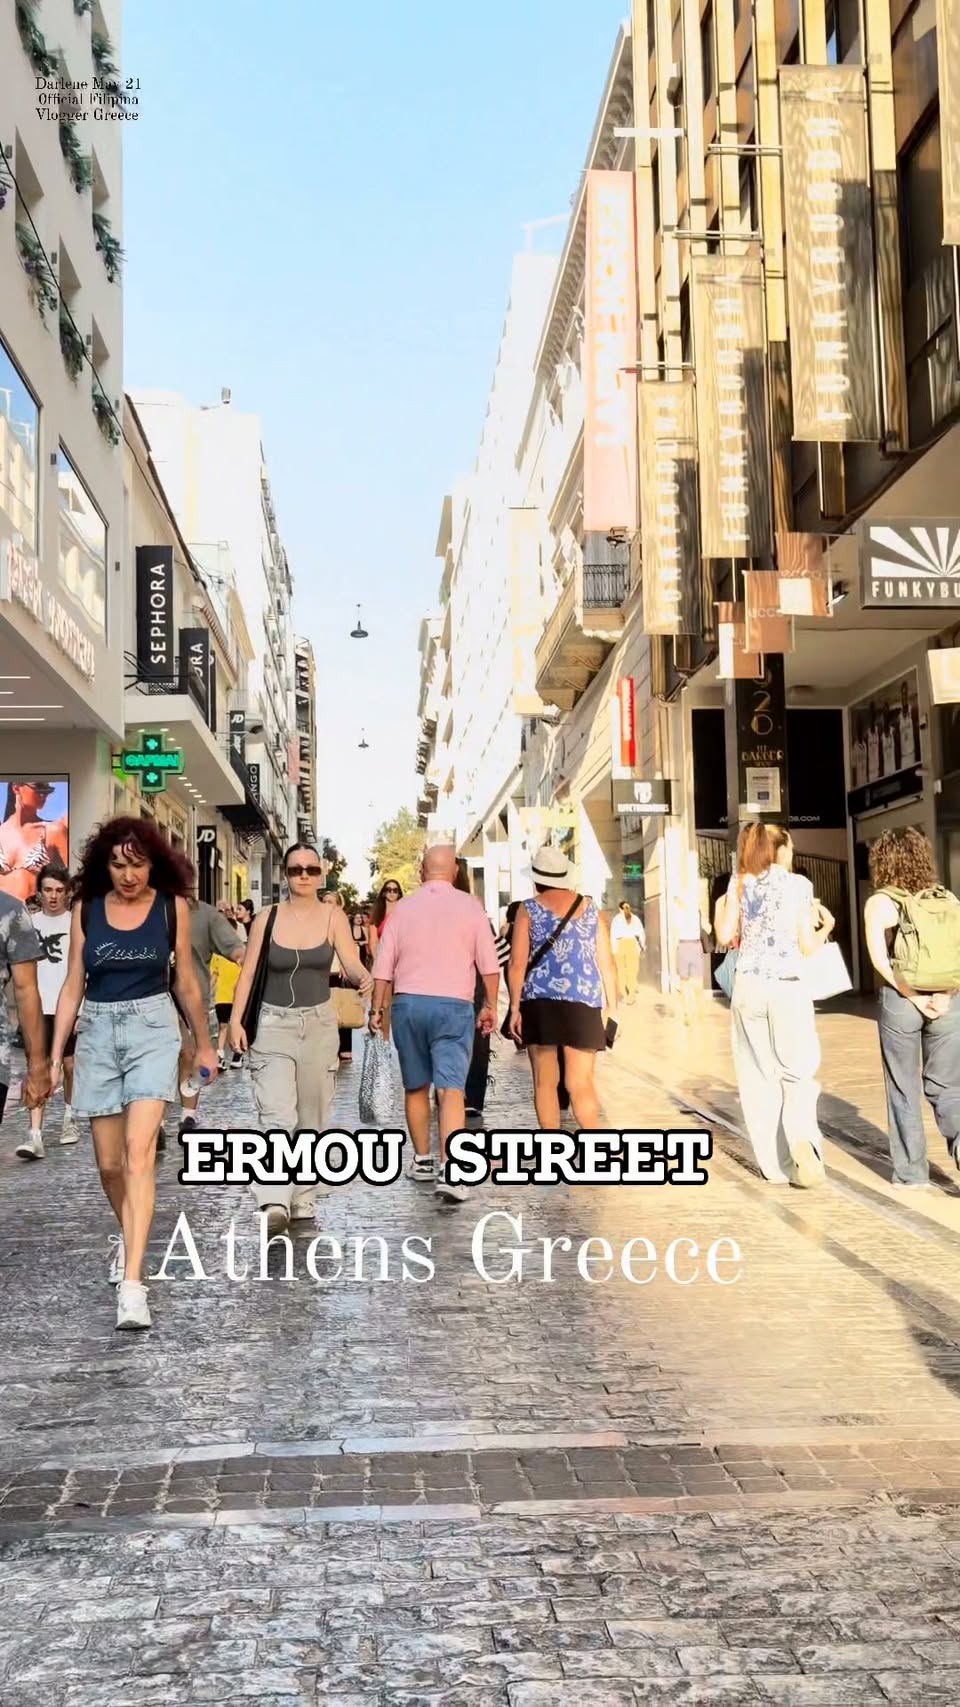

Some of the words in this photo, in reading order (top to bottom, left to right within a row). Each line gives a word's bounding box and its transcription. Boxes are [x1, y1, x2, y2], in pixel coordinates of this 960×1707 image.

[871, 580, 960, 598] FUNKYBU
[150, 563, 166, 664] SEPHORA
[230, 714, 244, 725] JD
[196, 829, 216, 844] JD
